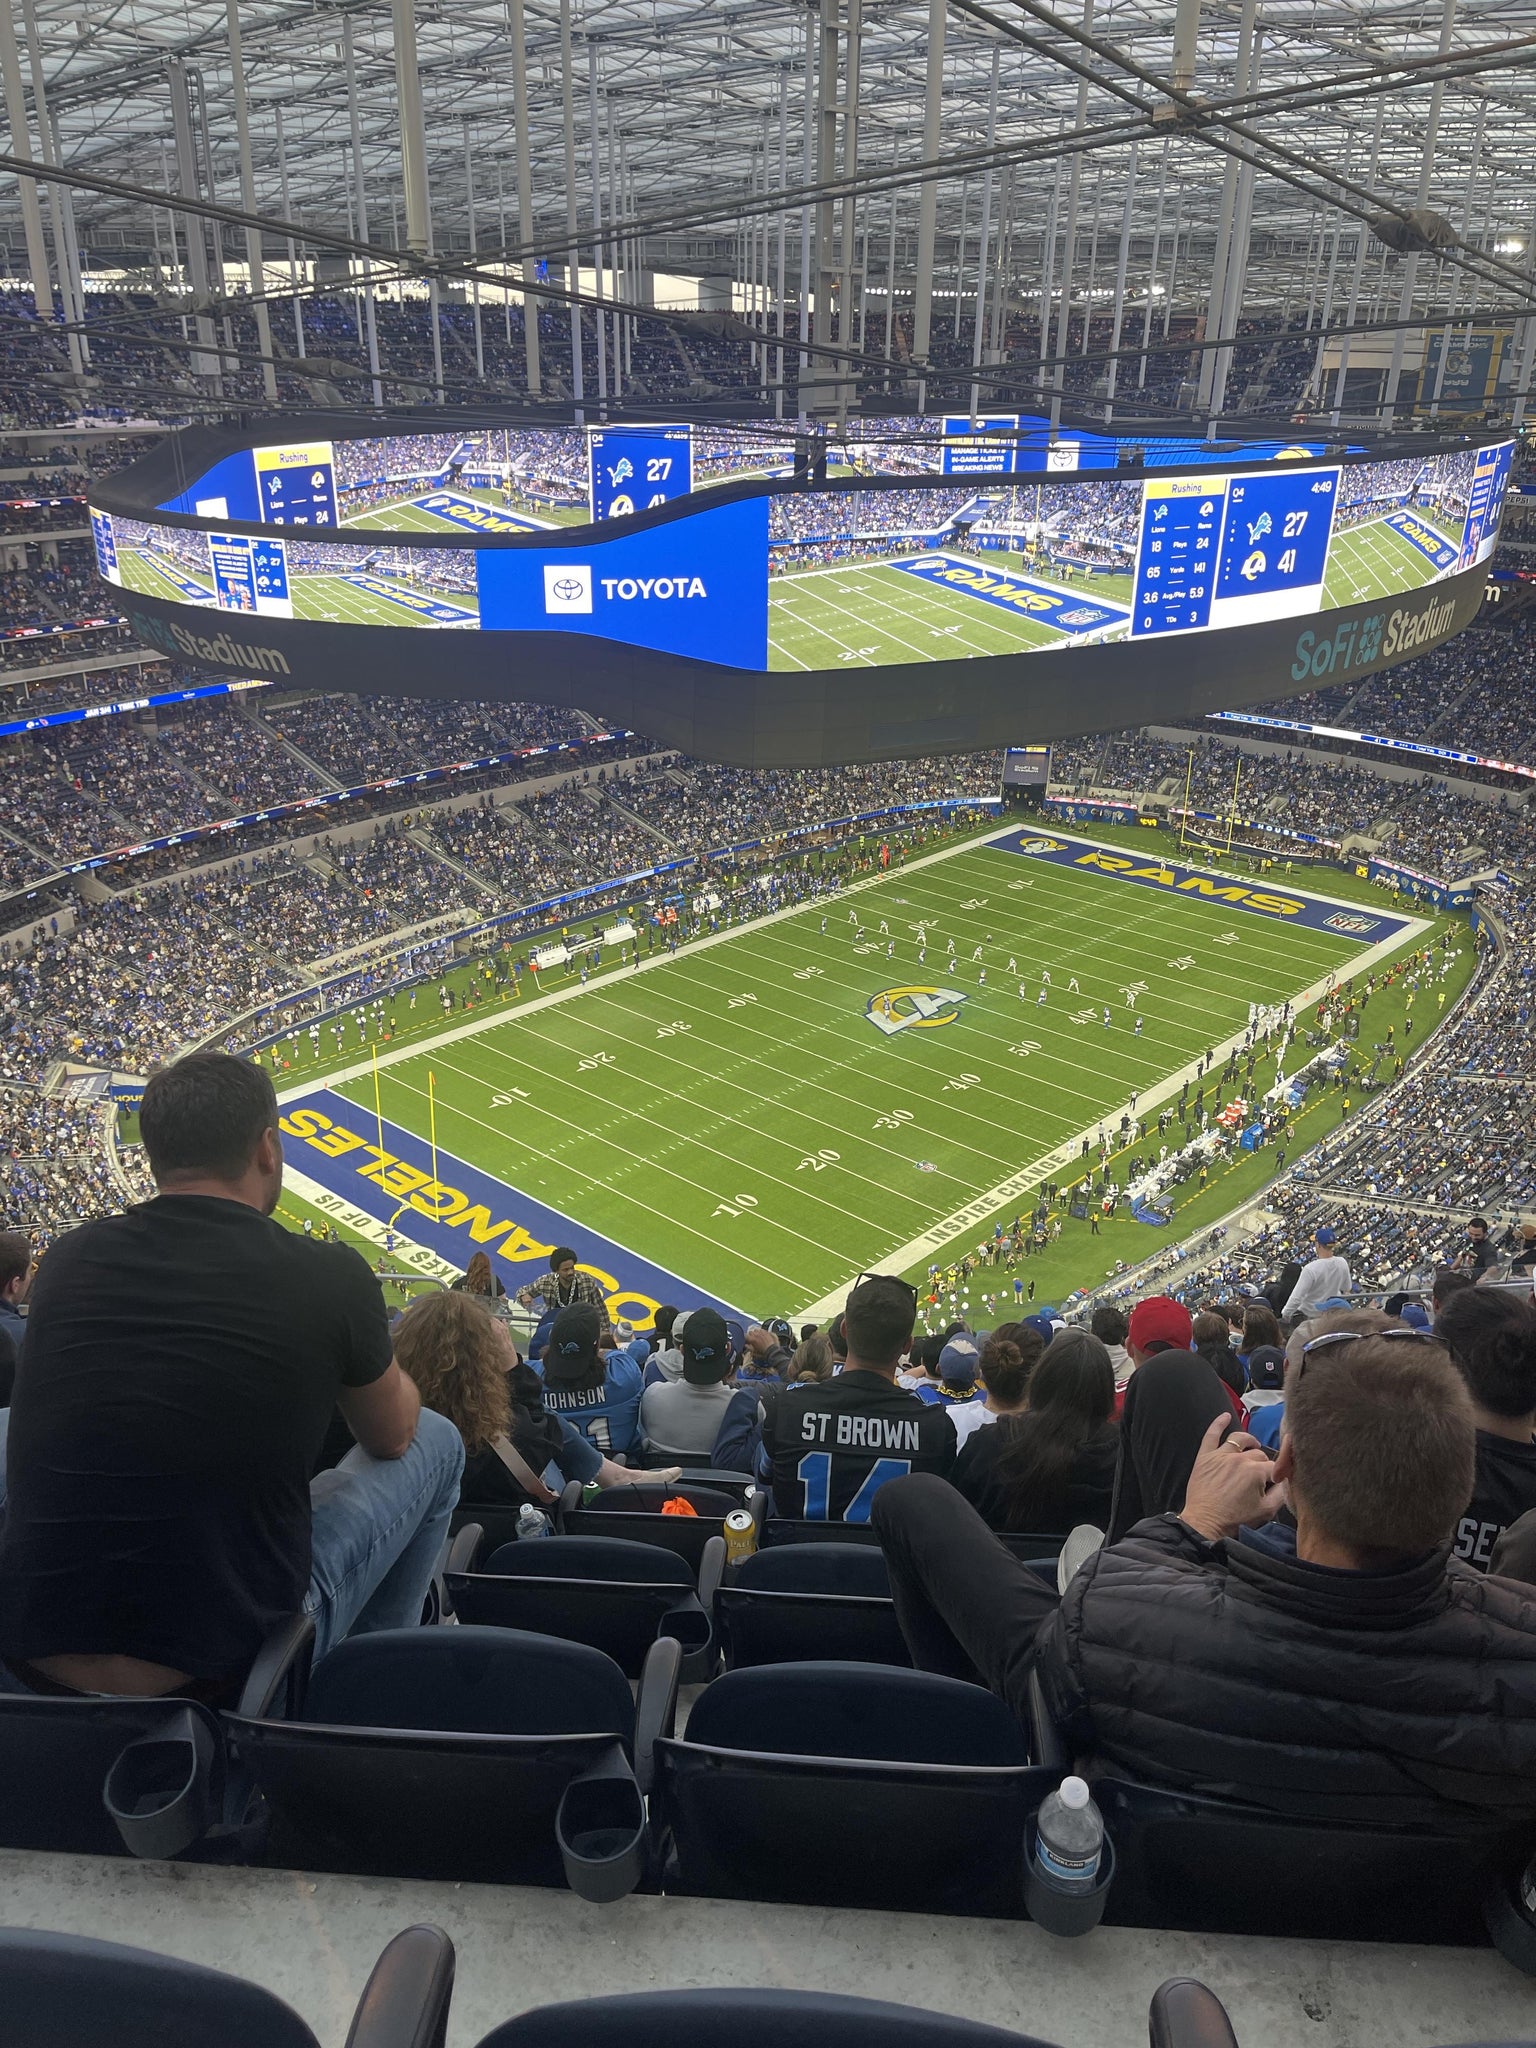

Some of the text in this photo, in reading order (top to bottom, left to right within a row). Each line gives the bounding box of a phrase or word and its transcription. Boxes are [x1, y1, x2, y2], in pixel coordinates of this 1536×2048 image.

[592, 434, 603, 443] 04
[280, 452, 308, 464] Rushing
[647, 458, 672, 481] 27
[1172, 484, 1202, 494] Rushing
[1233, 481, 1332, 498] 04 4:49
[1283, 512, 1308, 537] 27
[1151, 541, 1162, 553] 18
[1196, 538, 1209, 549] 24
[1401, 522, 1441, 553] RAMS
[270, 558, 281, 566] 27
[1147, 567, 1160, 578] 65
[1194, 562, 1206, 574] 141
[1278, 549, 1296, 573] 41
[361, 582, 434, 608] RAMS
[601, 578, 707, 600] TOYOTA
[934, 568, 1063, 611] RAMS
[1143, 592, 1159, 604] 3.6
[1190, 587, 1204, 599] 5.9
[1144, 617, 1152, 628] 0
[1190, 611, 1197, 622] 3
[170, 622, 291, 674] Stadium
[1291, 596, 1456, 681] SoFi Stadium
[793, 823, 826, 836] HOUSE
[1257, 823, 1298, 838] HOUSE
[1074, 852, 1306, 915] RAMS
[405, 937, 446, 958] HOUSE
[1213, 936, 1239, 945] 10
[793, 965, 825, 980] 50
[1168, 956, 1196, 971] 20
[1069, 1010, 1097, 1025] 40
[665, 1020, 693, 1038] 30
[1008, 1040, 1042, 1057] 50
[585, 1051, 616, 1070] 20
[948, 1073, 982, 1090] 40
[499, 1086, 531, 1106] 10
[877, 1109, 914, 1129] 30
[801, 1149, 841, 1172] 20
[279, 1109, 558, 1263] ANGELES
[314, 1194, 345, 1212] US
[717, 1193, 760, 1218] 10
[924, 1152, 1067, 1245] INSPIRE CHANGE
[341, 1213, 372, 1228] OF
[801, 1412, 920, 1451] ST BROWN
[797, 1451, 912, 1523] 14
[1453, 1517, 1507, 1562] SE
